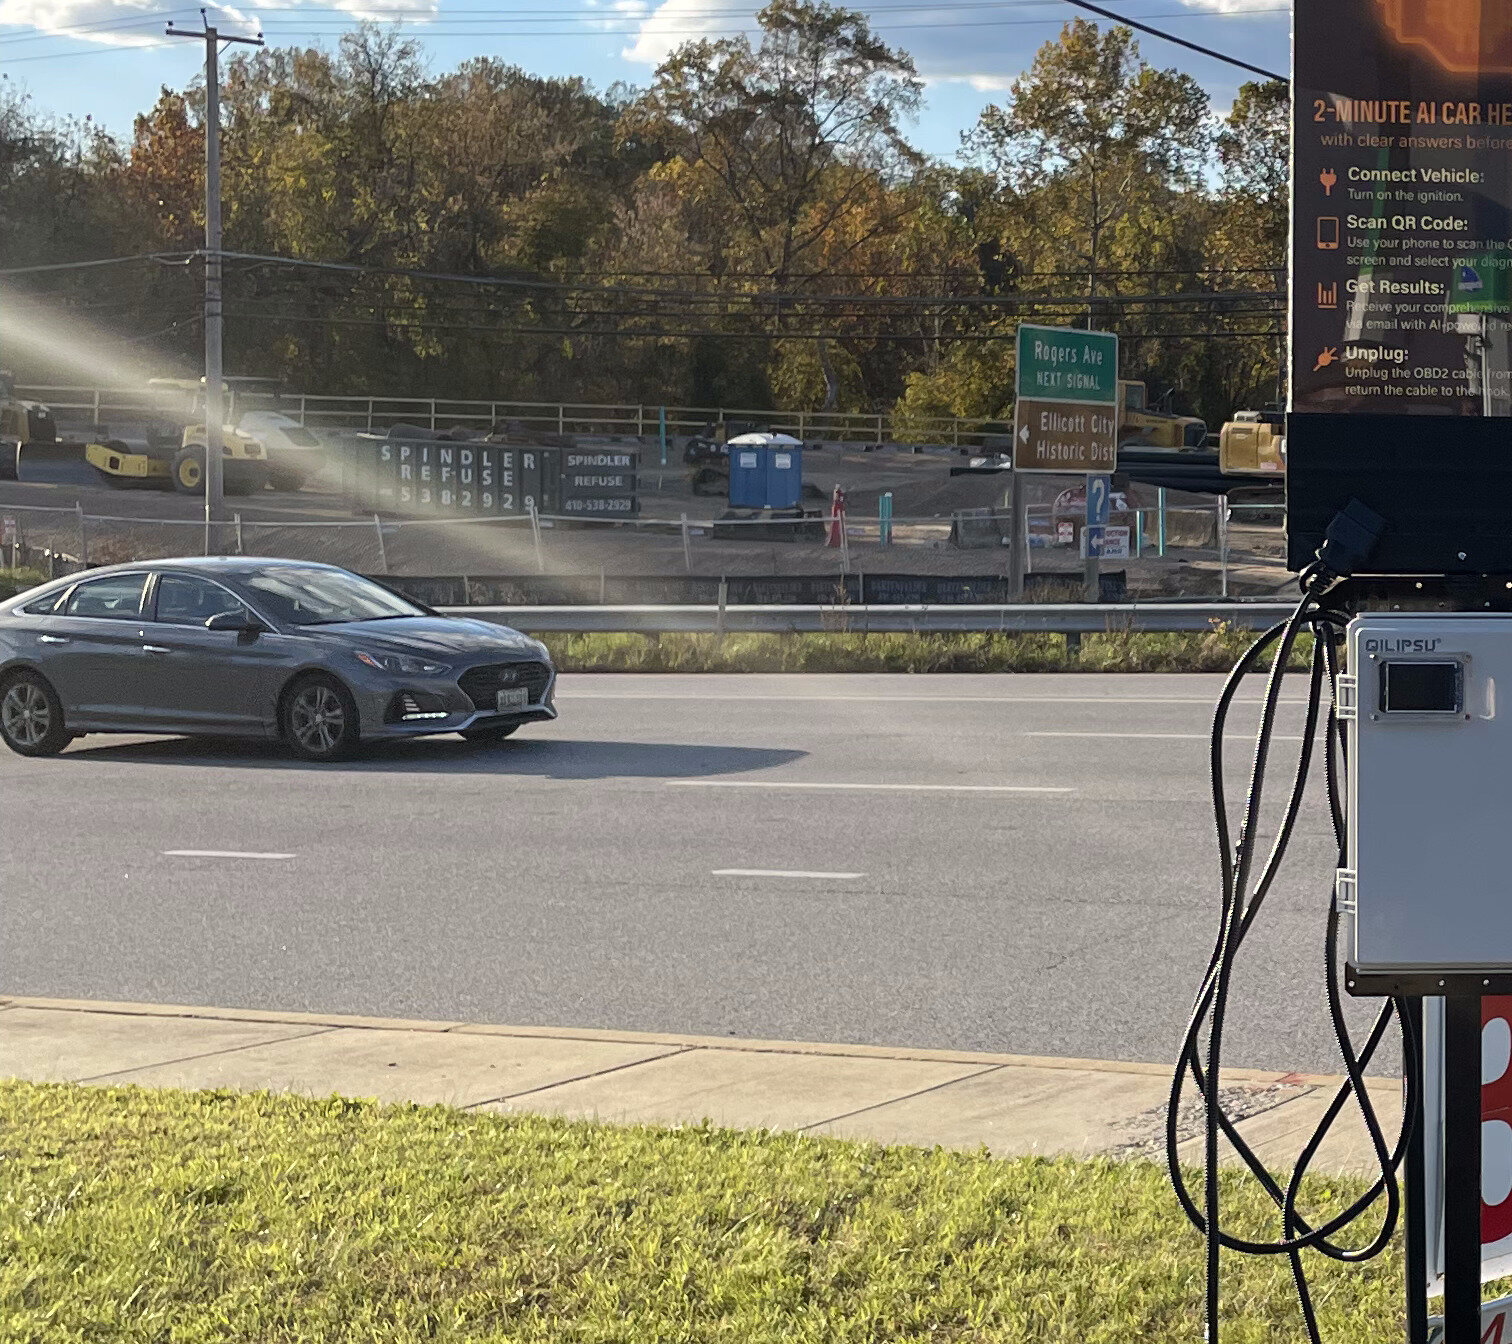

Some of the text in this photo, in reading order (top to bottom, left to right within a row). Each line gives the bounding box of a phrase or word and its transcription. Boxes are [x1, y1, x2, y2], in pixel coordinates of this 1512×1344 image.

[1313, 100, 1411, 124] 2-MINUTE
[1416, 101, 1436, 124] AI
[1441, 102, 1481, 125] CAR
[1321, 133, 1353, 147] with
[1357, 133, 1394, 148] clear
[1399, 138, 1462, 149] answers
[1347, 166, 1485, 183] Connect Vehicle:
[1348, 188, 1464, 204] Turn on the ignition.
[1346, 214, 1468, 231] Scan QR Code:
[1347, 236, 1370, 248] Use
[1373, 238, 1399, 251] your
[1402, 237, 1438, 250] phone
[1442, 238, 1455, 249] to
[1456, 240, 1484, 250] scan
[1486, 238, 1505, 251] the
[1346, 256, 1386, 266] screen
[1389, 255, 1411, 266] and
[1415, 255, 1449, 267] select
[1452, 257, 1478, 269] your
[1345, 279, 1445, 294] Get Results:
[1346, 301, 1392, 312] Receive
[1395, 303, 1421, 315] your
[1366, 318, 1397, 329] email
[1401, 319, 1426, 330] with
[1034, 340, 1103, 367] Rogers Ave
[1345, 345, 1409, 363] Unplug:
[1036, 370, 1100, 391] NEXT SIGNAL
[1345, 367, 1388, 380] Unplug
[1391, 367, 1411, 378] the
[1413, 367, 1448, 379] OBD2
[1345, 386, 1381, 395] return
[1384, 385, 1403, 396] the
[1405, 385, 1438, 396] cable
[1440, 386, 1453, 396] to
[1456, 385, 1475, 396] the
[1040, 411, 1115, 438] Ellicott City
[381, 445, 535, 469] SPINDLER
[1036, 440, 1114, 462] Historic Dist
[567, 454, 631, 467] SPINDLER
[400, 464, 513, 486] REFUSE
[574, 475, 624, 487] REFUSE
